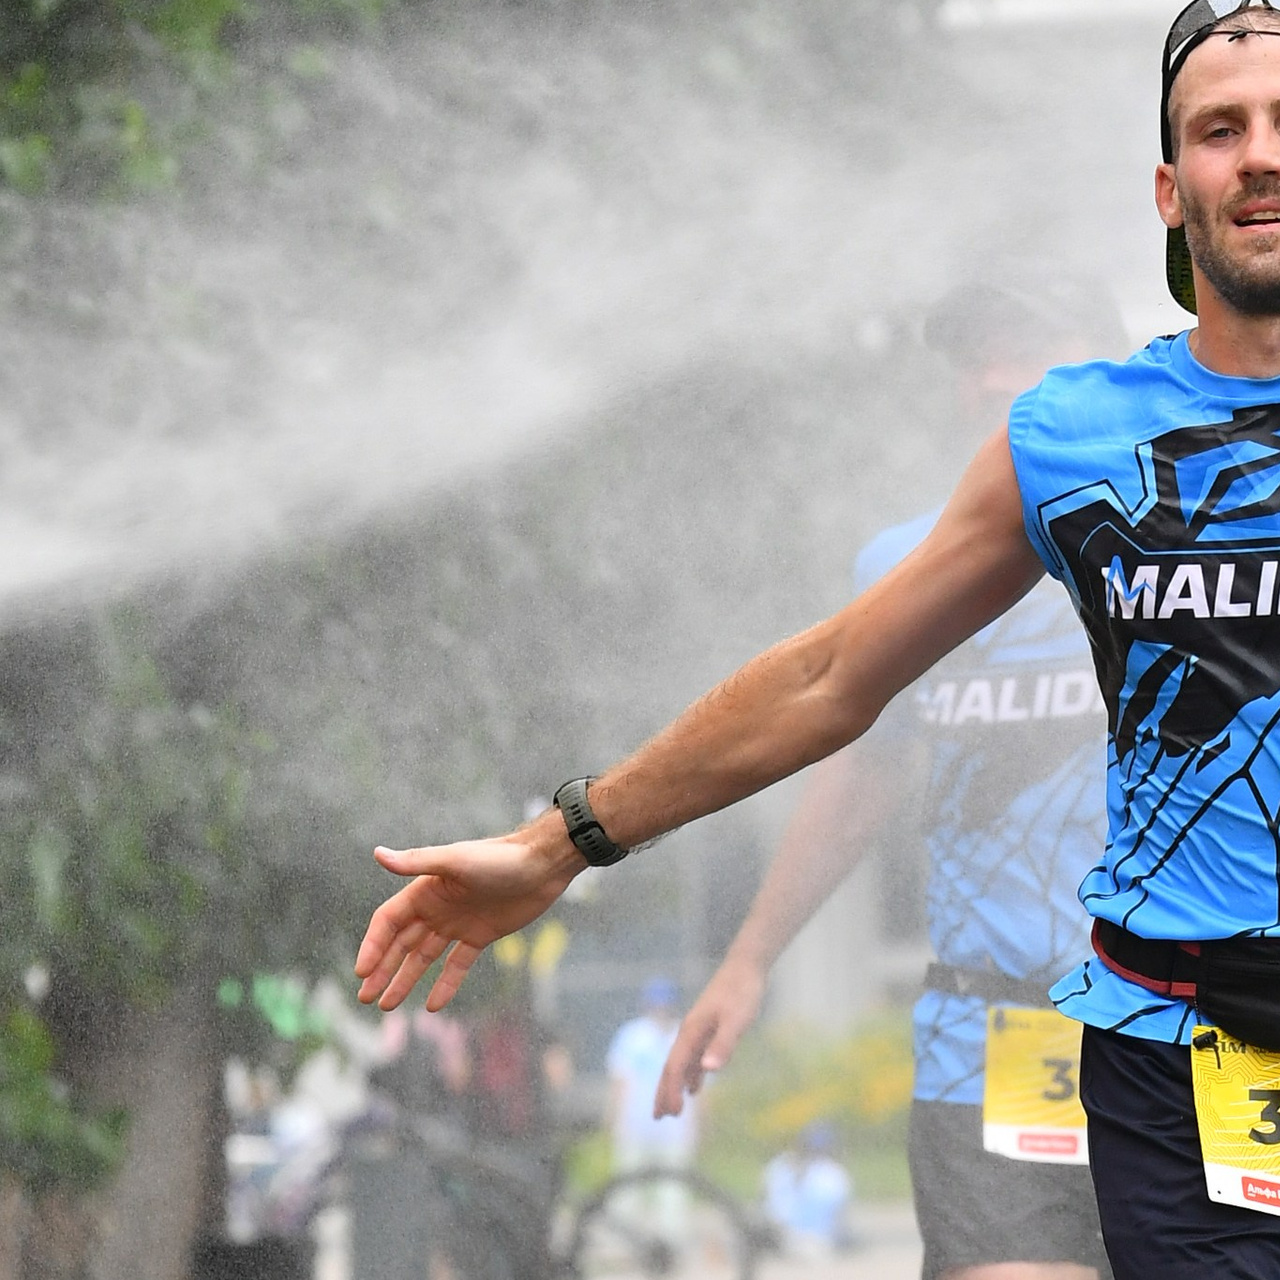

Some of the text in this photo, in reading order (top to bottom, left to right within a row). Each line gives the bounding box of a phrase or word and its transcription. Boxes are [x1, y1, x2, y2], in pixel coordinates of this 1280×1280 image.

[915, 670, 1107, 724] MALID
[1042, 1058, 1076, 1101] 3
[1247, 1183, 1277, 1199] Альфа
